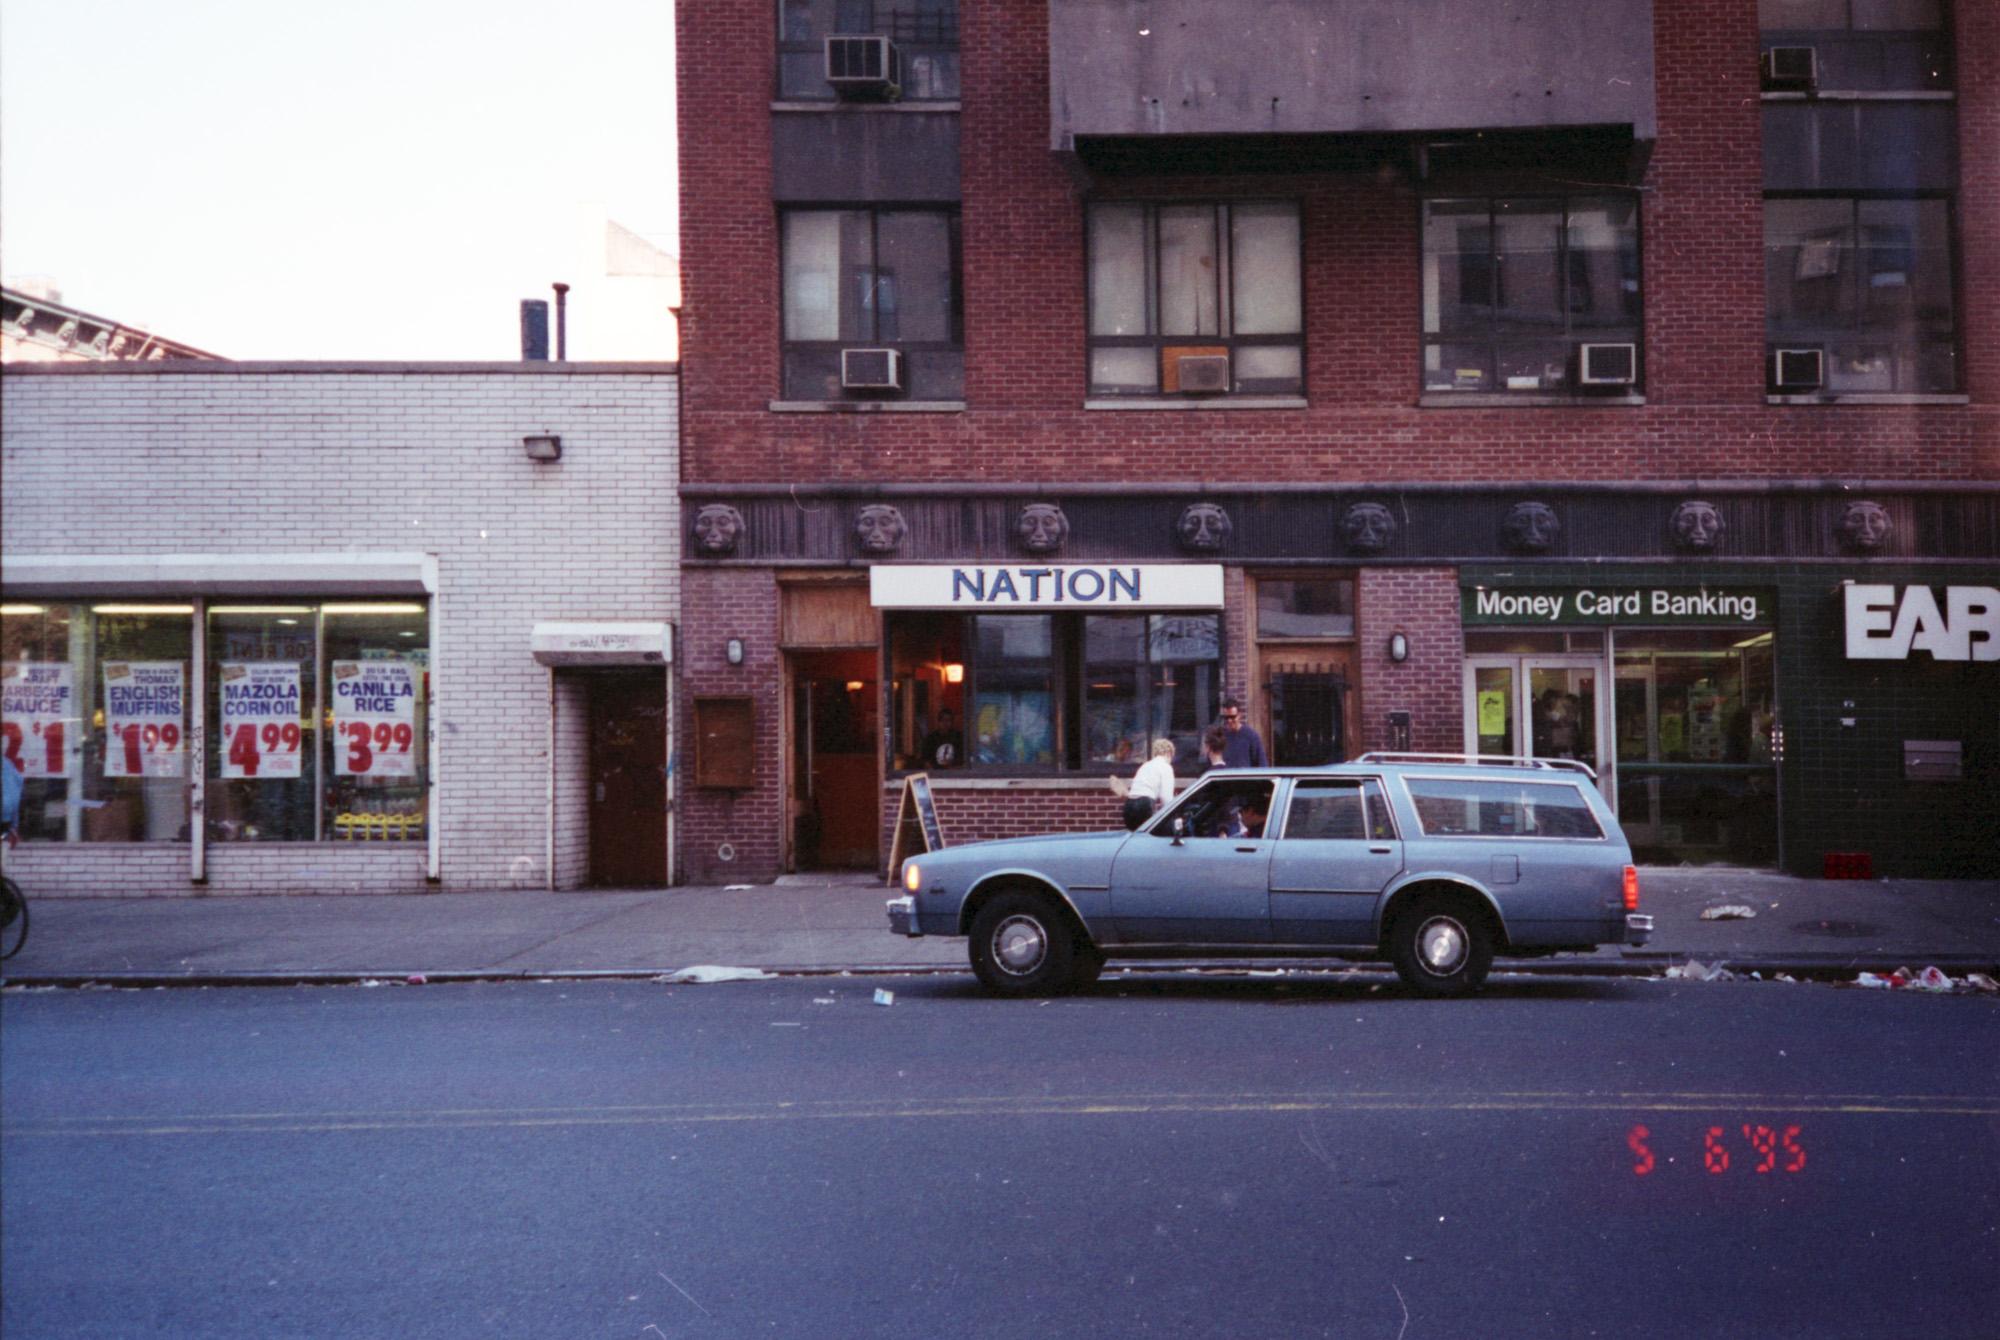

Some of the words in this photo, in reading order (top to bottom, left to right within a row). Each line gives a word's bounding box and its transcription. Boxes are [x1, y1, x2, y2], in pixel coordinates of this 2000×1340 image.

[952, 568, 1142, 602] NATION
[1476, 590, 1563, 620] Money
[1575, 590, 1640, 616] Card
[1651, 590, 1757, 620] Banking
[1844, 583, 2000, 662] EAB
[110, 686, 181, 700] ENGLISH
[225, 684, 299, 699] MAZOLA
[338, 681, 414, 697] CANILLA
[3, 699, 62, 713] SAUCE
[111, 701, 182, 715] MUFFINS
[225, 701, 271, 716] CORN
[273, 701, 299, 715] OIL
[355, 698, 396, 712] RICE
